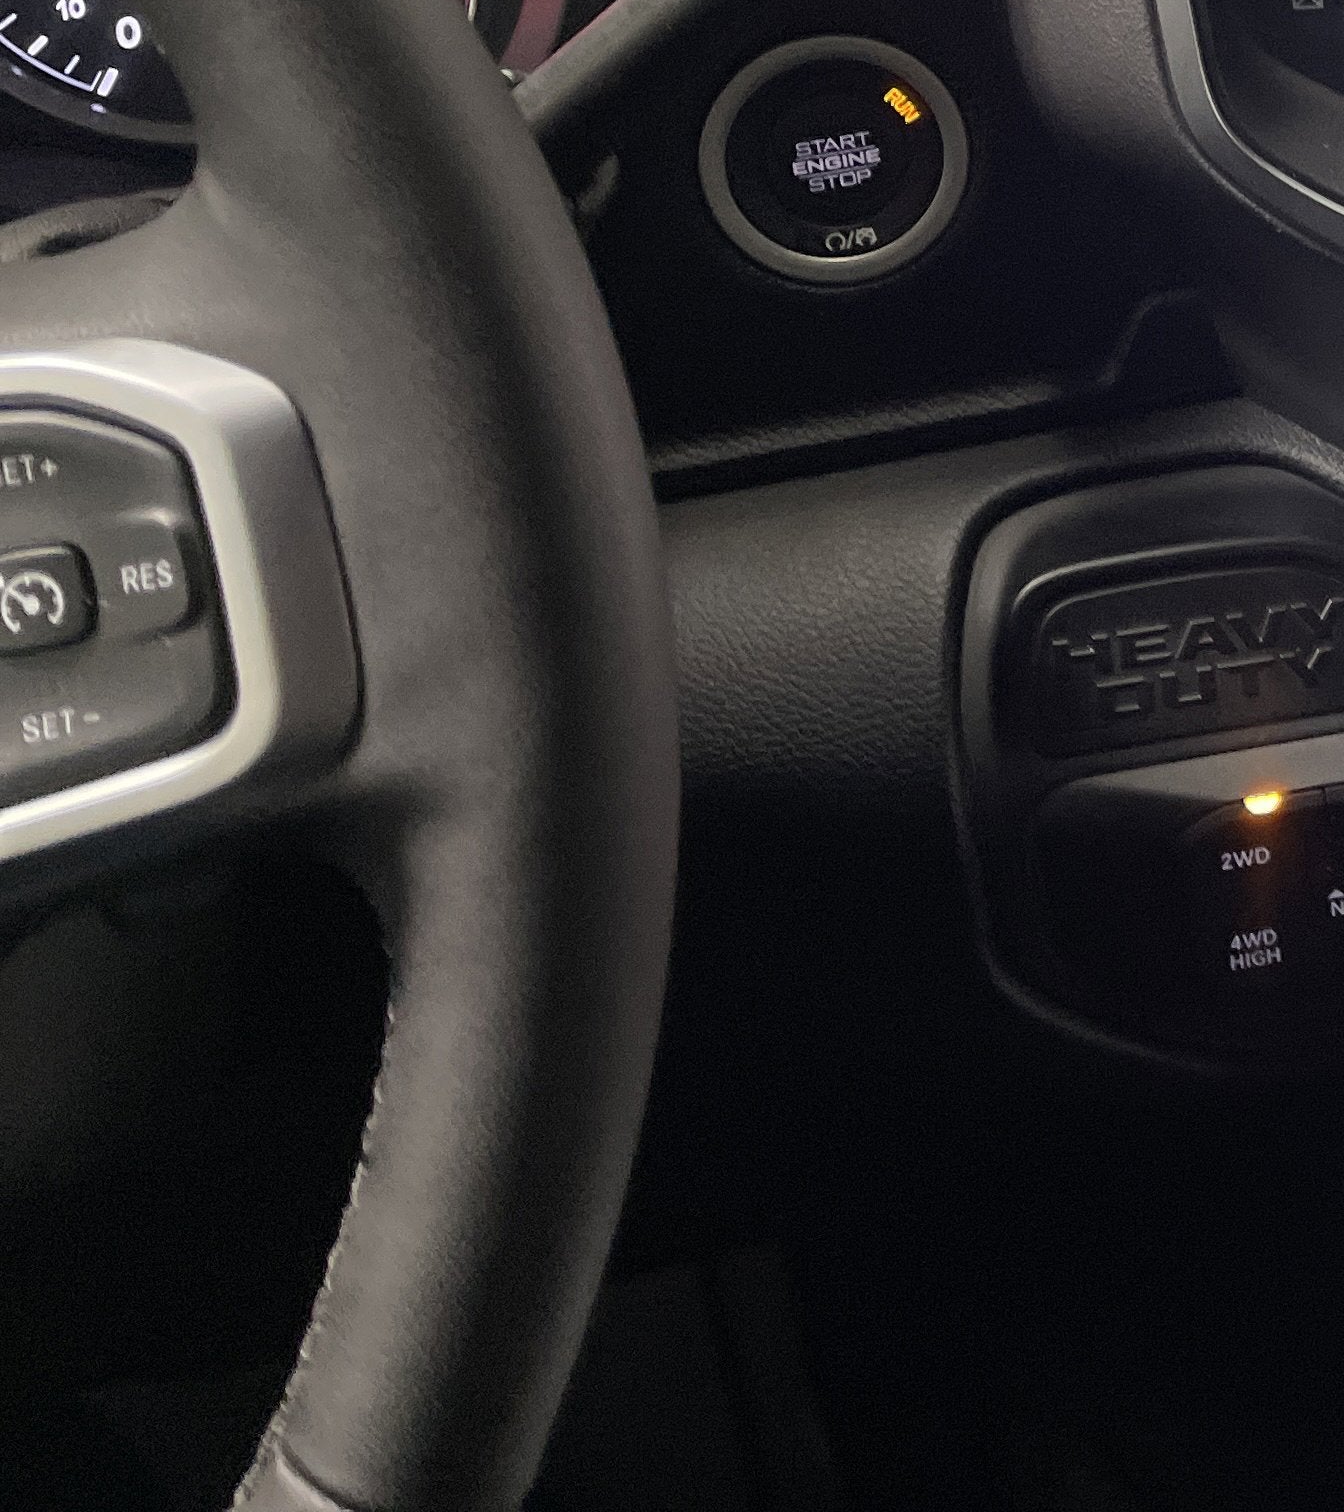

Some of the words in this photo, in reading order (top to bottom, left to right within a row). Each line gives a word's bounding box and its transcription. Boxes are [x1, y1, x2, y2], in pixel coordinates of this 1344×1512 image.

[115, 15, 142, 50] 0
[883, 87, 922, 125] RUN
[795, 130, 871, 158] START
[792, 147, 881, 176] ENGINE
[809, 168, 872, 194] STOP
[0, 453, 35, 487] ET
[121, 559, 174, 595] RES
[1221, 846, 1272, 871] 2WD
[1230, 927, 1278, 951] 4WD
[1230, 946, 1283, 971] HIGH
